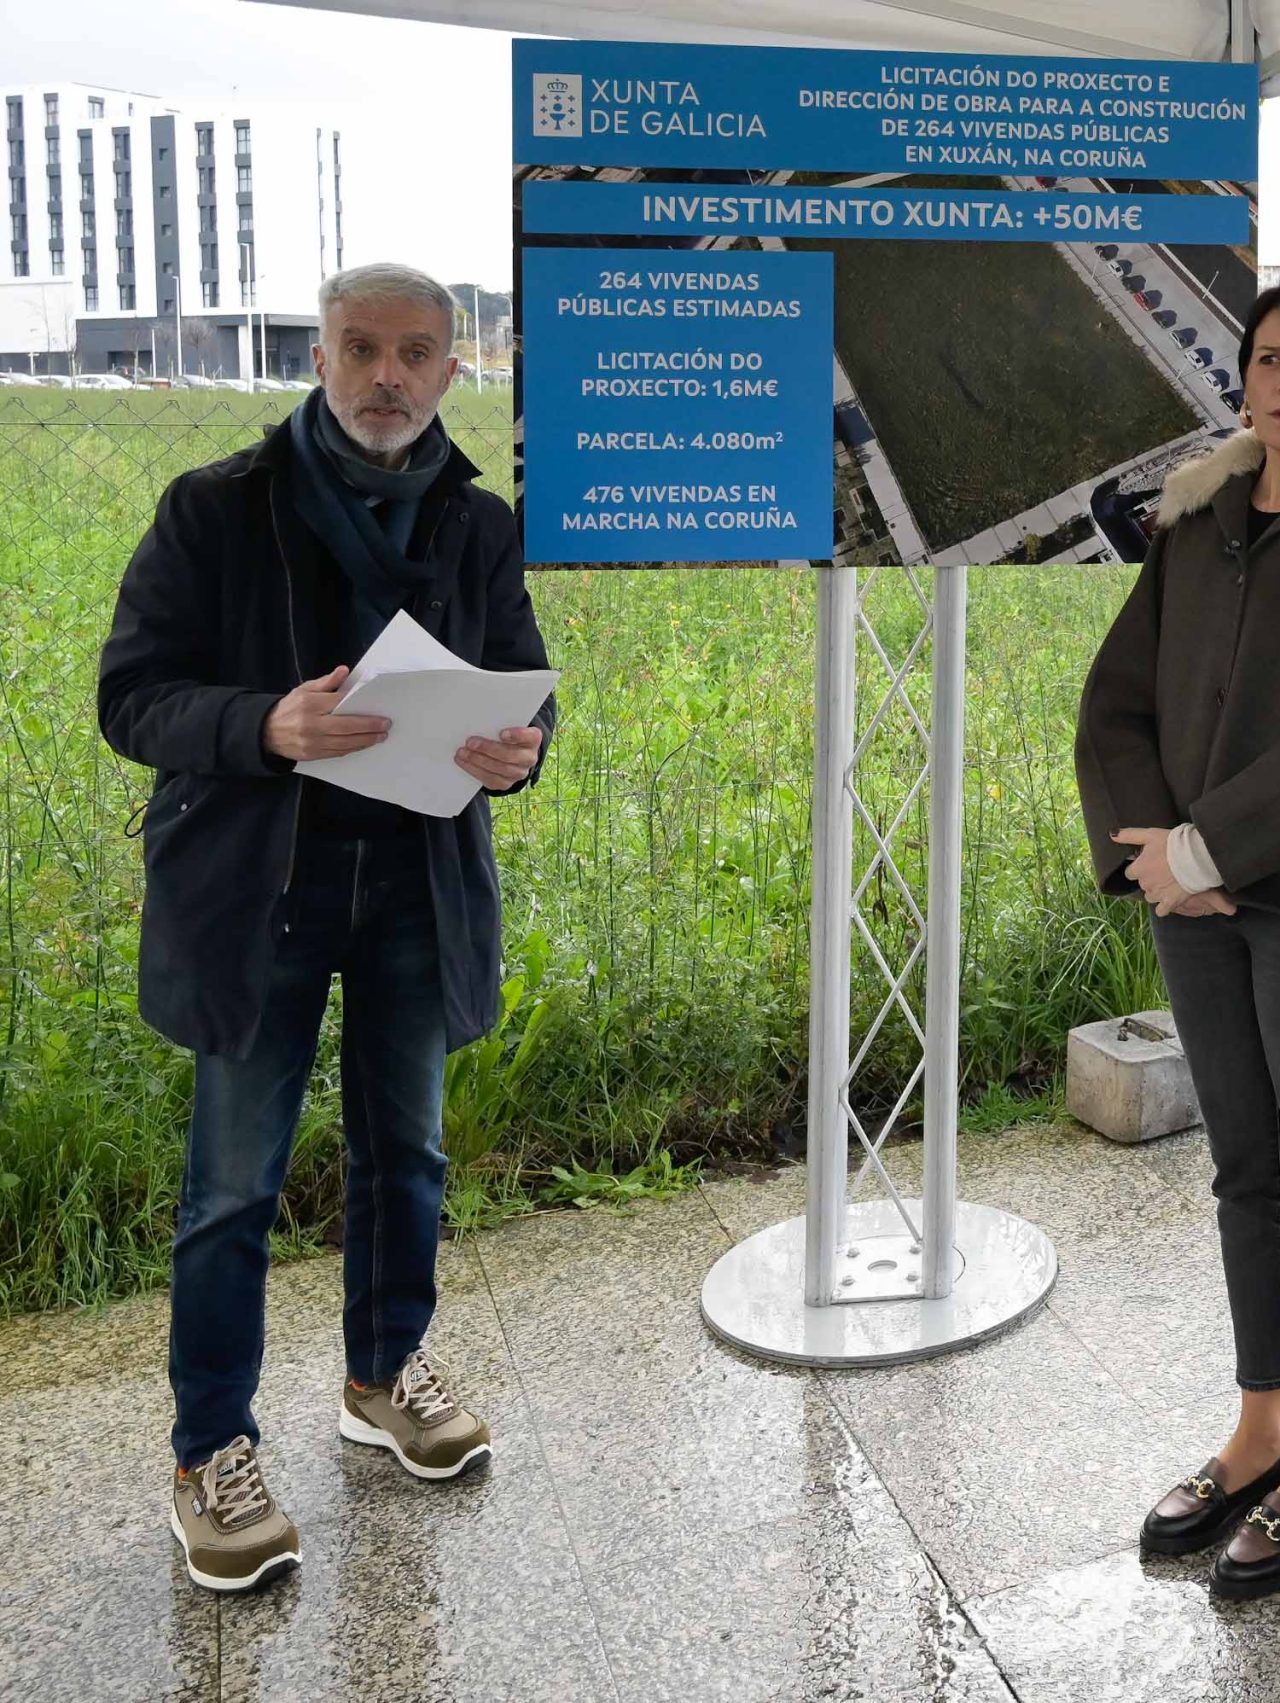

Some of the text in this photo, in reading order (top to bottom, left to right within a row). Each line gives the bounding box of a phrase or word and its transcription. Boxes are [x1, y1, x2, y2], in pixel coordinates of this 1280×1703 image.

[882, 65, 1169, 92] LICITACIÓN DO PROXECTO E
[592, 80, 699, 104] XUNTA
[800, 88, 1245, 119] DIRECCIÓN DE OBRA PARA A CONSTRUCIÓN
[591, 110, 766, 136] DE GALICIA
[882, 119, 1169, 143] DE 264 VIVENDAS PÚBLICAS
[906, 143, 1146, 167] EN XUXÁN, NA CORUÑA
[644, 196, 1142, 230] INVESTIMENTO XUNTA: +50M€
[601, 272, 759, 290] 264 VIVENDAS
[559, 294, 800, 317] PÚBLICAS ESTIMADAS
[598, 348, 762, 370] LICITACIÓN DO
[582, 379, 777, 399] PROXECTO: 1,6M€
[578, 433, 684, 449] PARCELA:
[584, 486, 775, 503] 476 VIVENDAS EN
[563, 507, 797, 529] MARCHA NA CORUÑA
